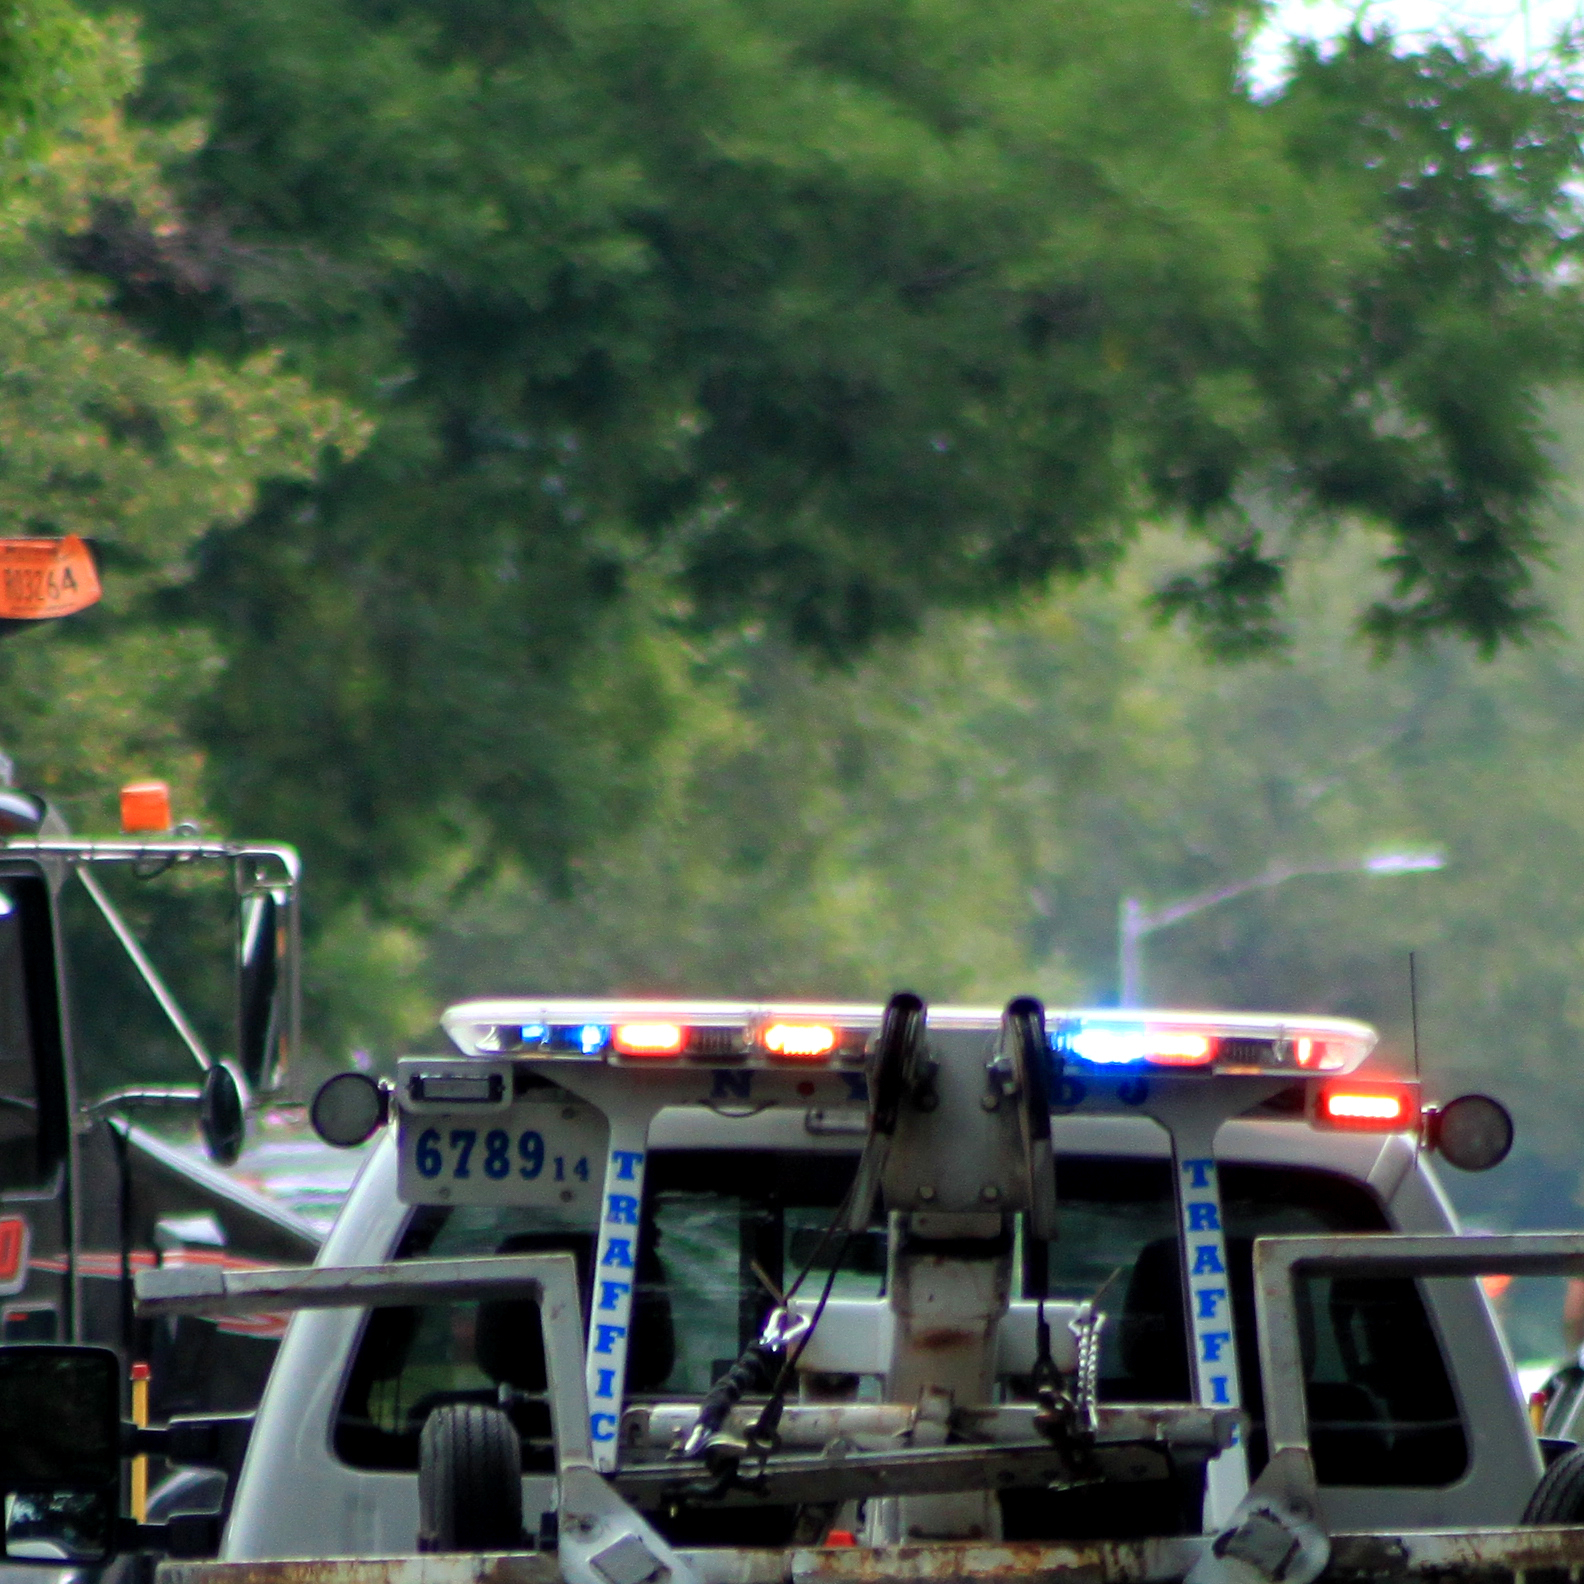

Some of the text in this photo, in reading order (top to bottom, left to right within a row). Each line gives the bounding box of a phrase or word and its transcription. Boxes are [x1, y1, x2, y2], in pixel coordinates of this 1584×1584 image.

[415, 1128, 590, 1182] 6789 14
[590, 1150, 644, 1442] TRAFFIC
[1181, 1158, 1241, 1447] TRAFFI
